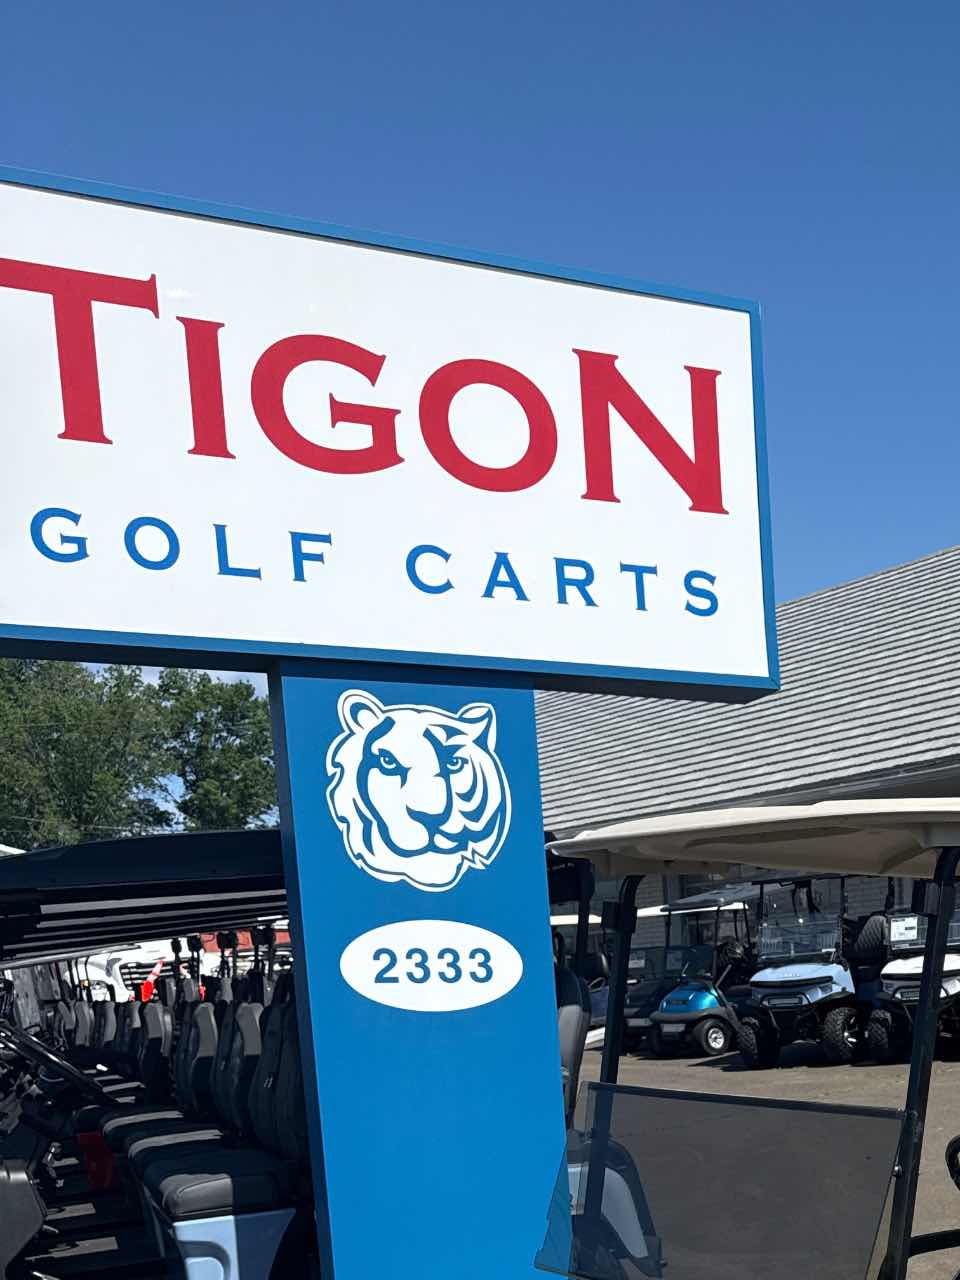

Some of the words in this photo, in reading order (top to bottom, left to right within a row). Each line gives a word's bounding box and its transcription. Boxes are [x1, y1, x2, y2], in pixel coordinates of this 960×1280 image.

[0, 258, 729, 515] TIGON
[30, 508, 332, 582] GOLF
[406, 544, 720, 617] CARTS
[372, 947, 493, 984] 2333
